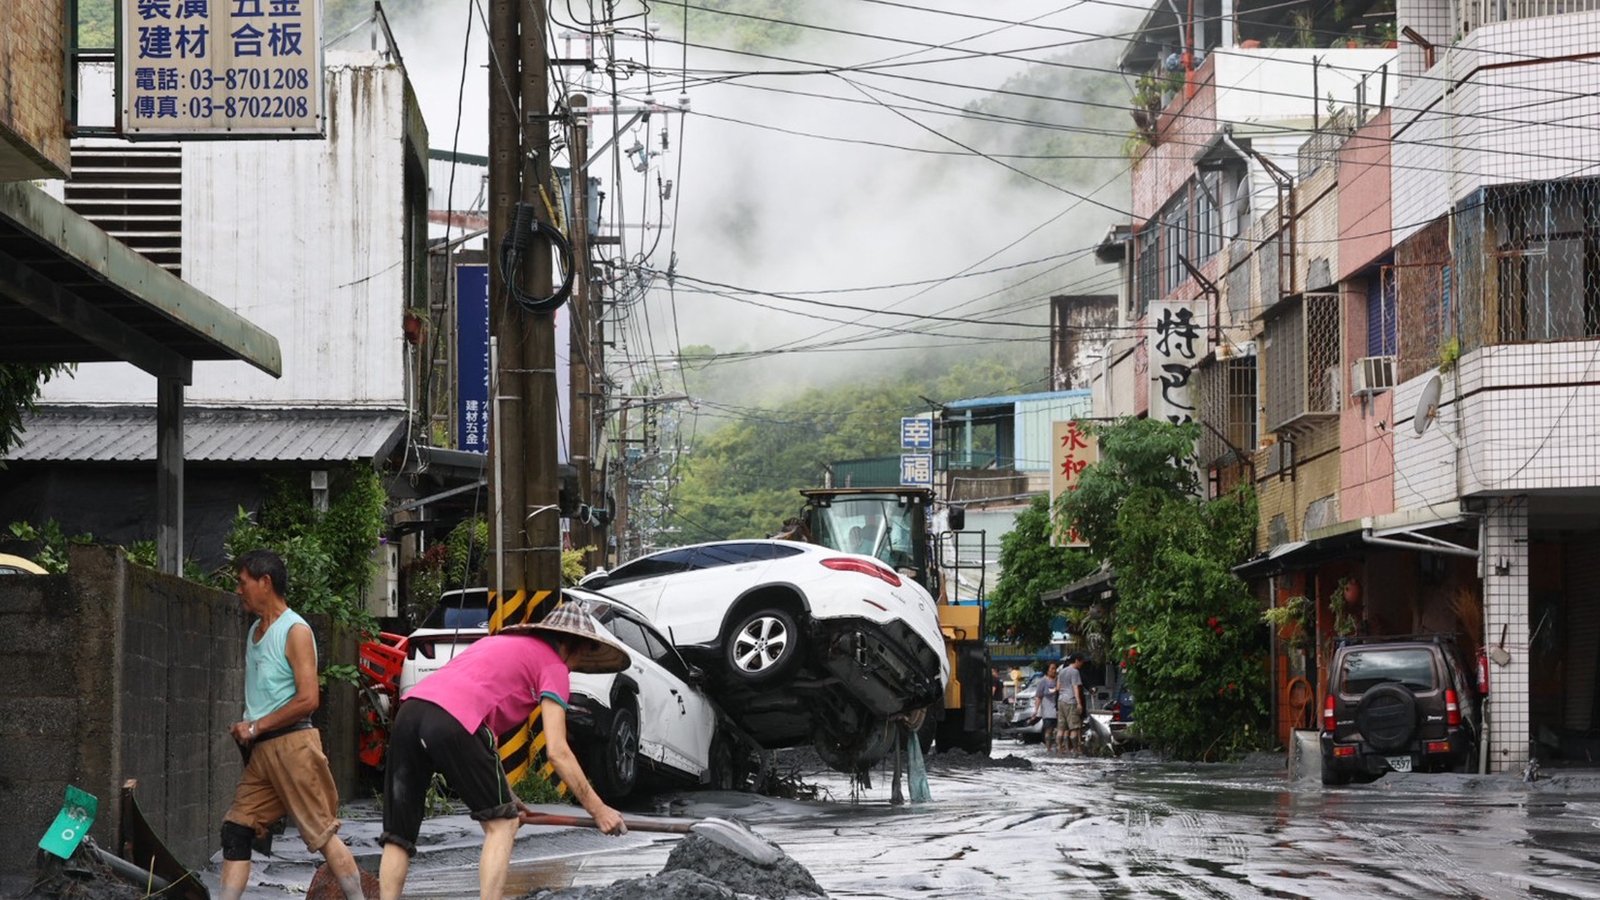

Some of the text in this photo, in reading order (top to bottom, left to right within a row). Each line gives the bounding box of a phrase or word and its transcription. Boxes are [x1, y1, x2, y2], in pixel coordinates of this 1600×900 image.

[138, 22, 302, 59] 建材 合板
[465, 400, 479, 445] 建材五金
[904, 419, 930, 482] 幸福
